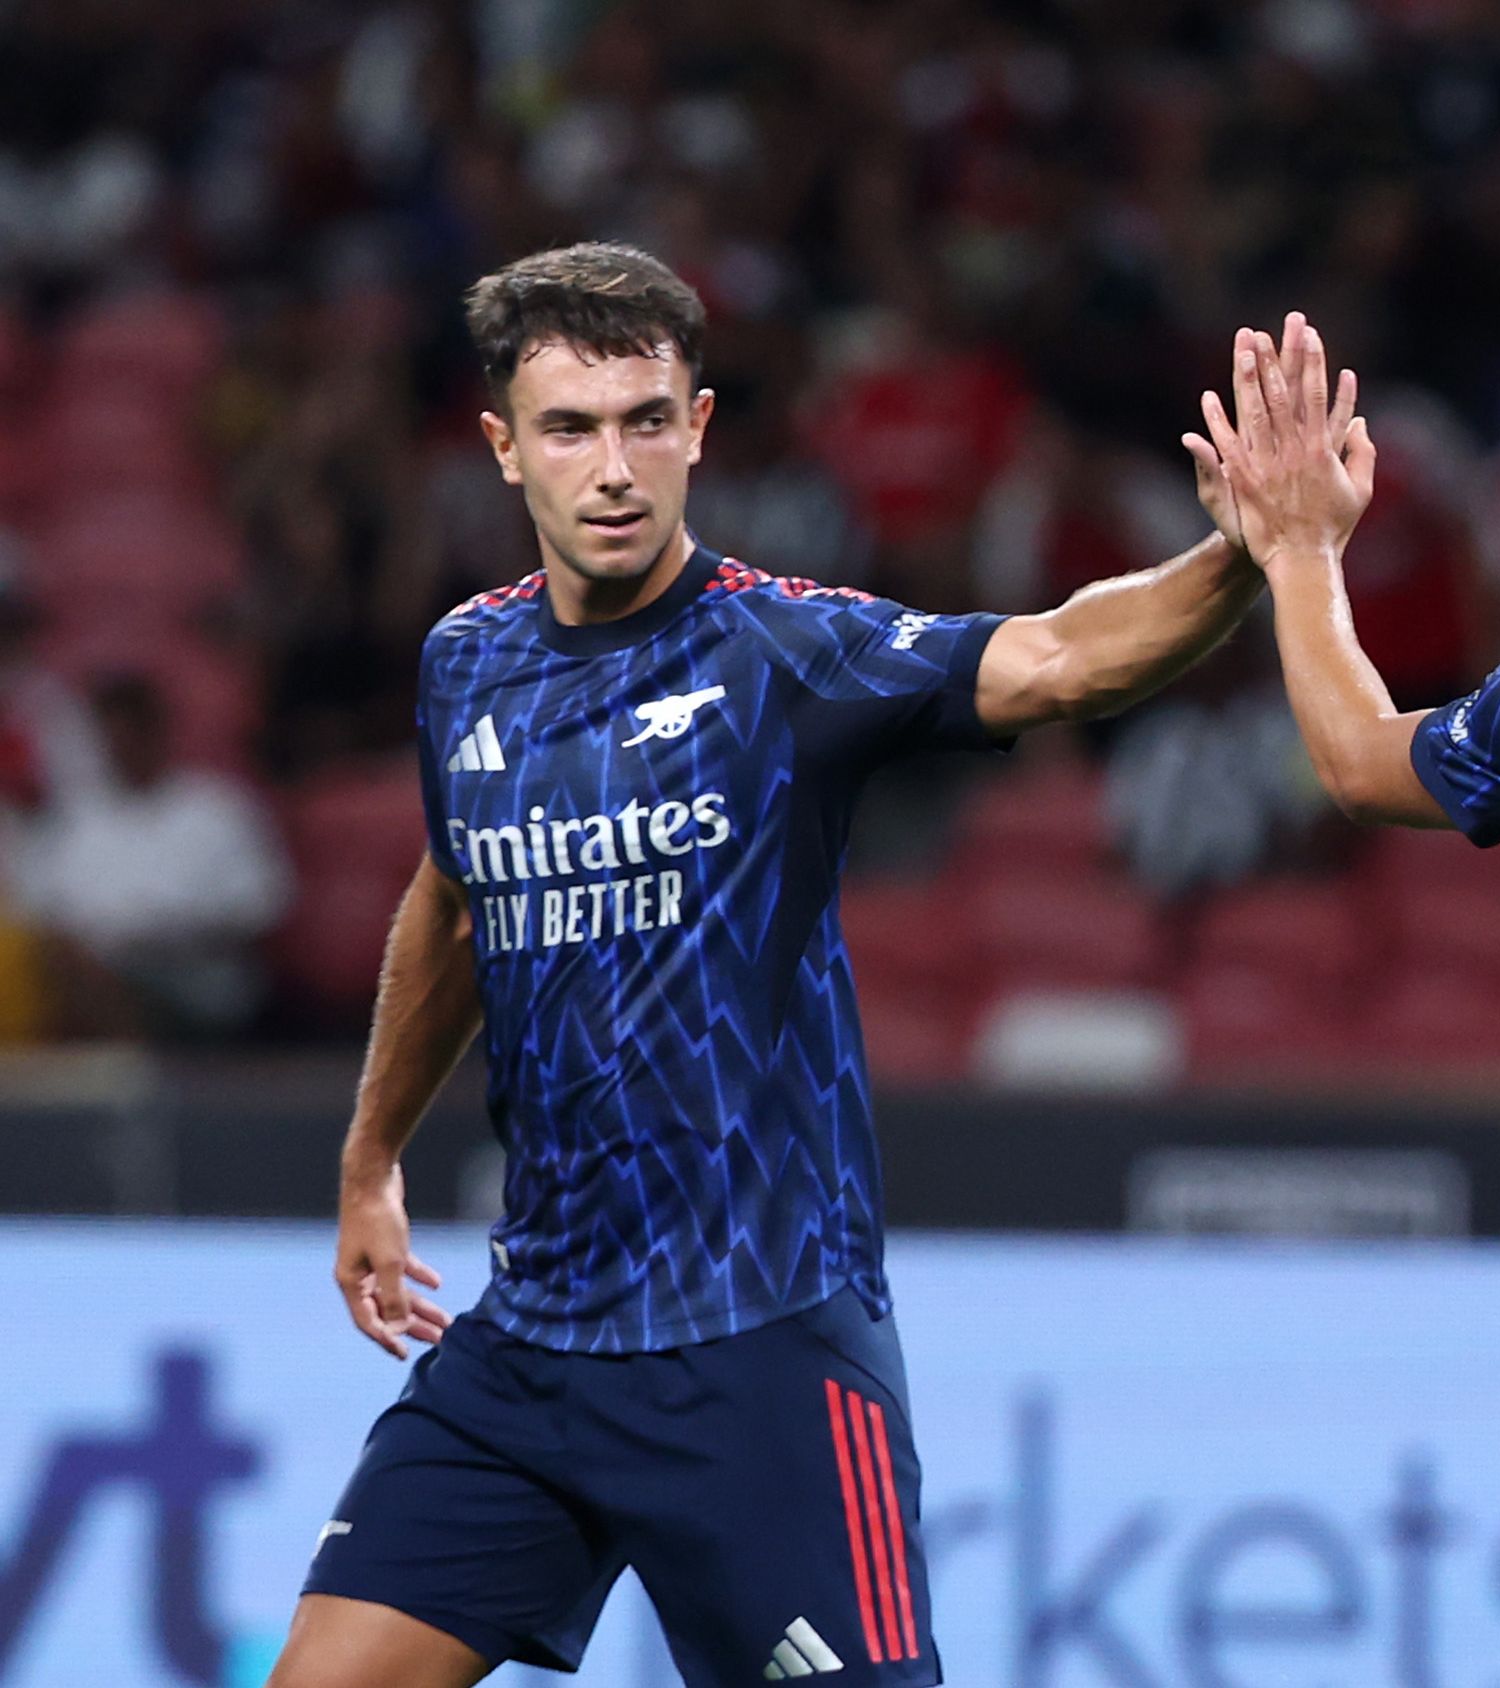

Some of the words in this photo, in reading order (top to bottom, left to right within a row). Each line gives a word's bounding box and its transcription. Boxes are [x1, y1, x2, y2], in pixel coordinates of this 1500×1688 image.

[447, 793, 730, 885] Emirates
[484, 893, 528, 952] FLY
[543, 870, 682, 947] BETTER
